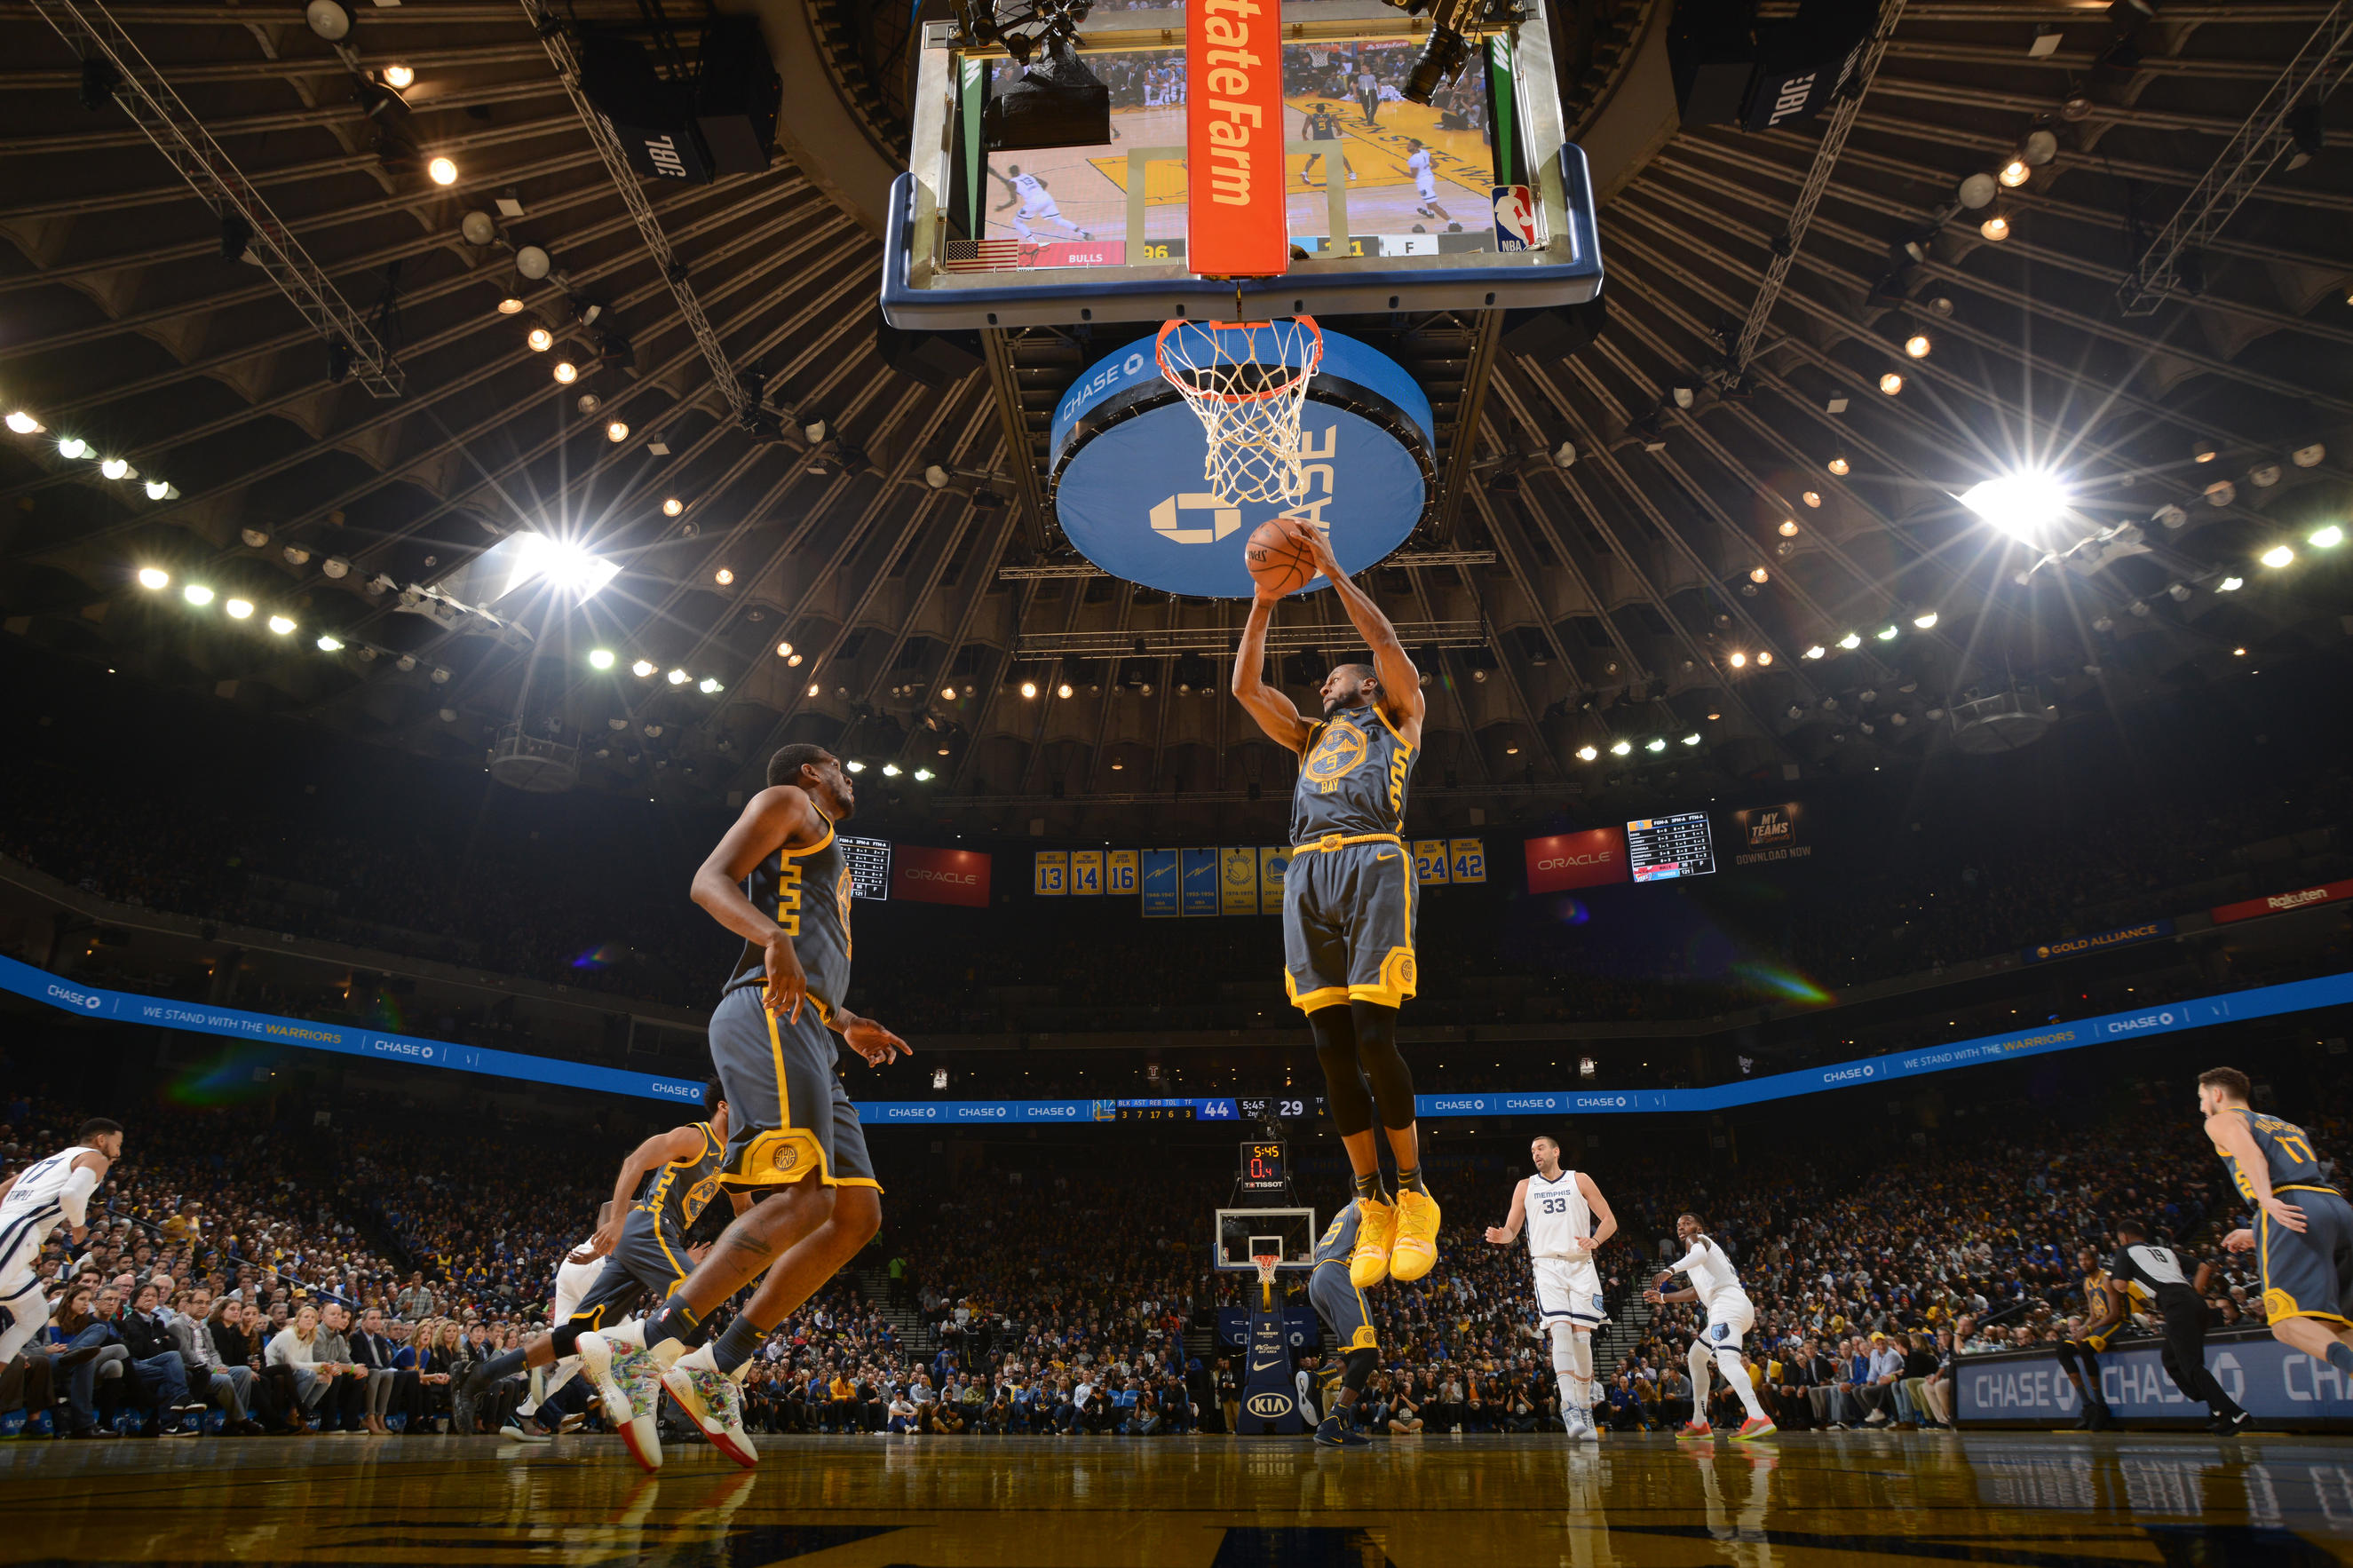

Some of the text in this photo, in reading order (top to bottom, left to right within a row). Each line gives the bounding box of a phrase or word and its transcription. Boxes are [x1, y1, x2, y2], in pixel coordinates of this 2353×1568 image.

[1768, 72, 1818, 126] JBL
[645, 135, 686, 178] JBL
[1145, 244, 1169, 257] 96
[1324, 241, 1364, 257] 11
[1406, 242, 1414, 254] F
[1502, 240, 1523, 252] NBA
[1069, 253, 1103, 263] BULLS
[1063, 363, 1121, 422] CHASE
[1279, 424, 1337, 546] ASE
[1330, 714, 1347, 725] HE
[1326, 755, 1338, 772] 9
[1321, 778, 1339, 794] BAY
[1762, 812, 1779, 826] MY
[1751, 822, 1789, 838] TEAMS
[1538, 852, 1612, 871] ORACLE
[1735, 845, 1811, 866] DOWNLOAD NOW
[1417, 856, 1446, 879] 24
[1454, 854, 1484, 877] 42
[905, 868, 978, 885] ORACLE
[1041, 867, 1063, 890] 13
[1076, 867, 1097, 890] 14
[1112, 867, 1135, 889] 16
[2268, 887, 2328, 909] Rakuten
[2051, 924, 2159, 954] GOLD ALLIANCE
[47, 984, 85, 1006] CHASE
[143, 1005, 342, 1044] WE STAND WITH THE WARRIORS
[2108, 1016, 2159, 1033] CHASE
[375, 1040, 420, 1056] CHASE
[1904, 1030, 2075, 1070] WE STAND WITH THE WARRIORS
[1823, 1068, 1862, 1083] CHASE
[652, 1082, 689, 1097] CHASE
[1204, 1101, 1229, 1117] 44
[1242, 1100, 1264, 1110] 5:45
[1279, 1100, 1303, 1116] 29
[1435, 1100, 1473, 1110] CHASE
[1506, 1098, 1544, 1109] CHASE
[1576, 1097, 1614, 1107] CHASE
[889, 1108, 924, 1117] CHASE
[958, 1107, 994, 1117] CHASE
[1027, 1106, 1064, 1116] CHASE
[1254, 1145, 1279, 1158] 5:45
[19, 1157, 67, 1184] 17
[1250, 1158, 1272, 1178] 0.4
[1533, 1189, 1571, 1200] MEMPHIS
[1542, 1198, 1566, 1214] 33
[2146, 1248, 2168, 1263] 19
[1975, 1374, 2049, 1408] CHASE
[2102, 1364, 2198, 1405] CHAS
[1255, 1398, 1285, 1413] KIA
